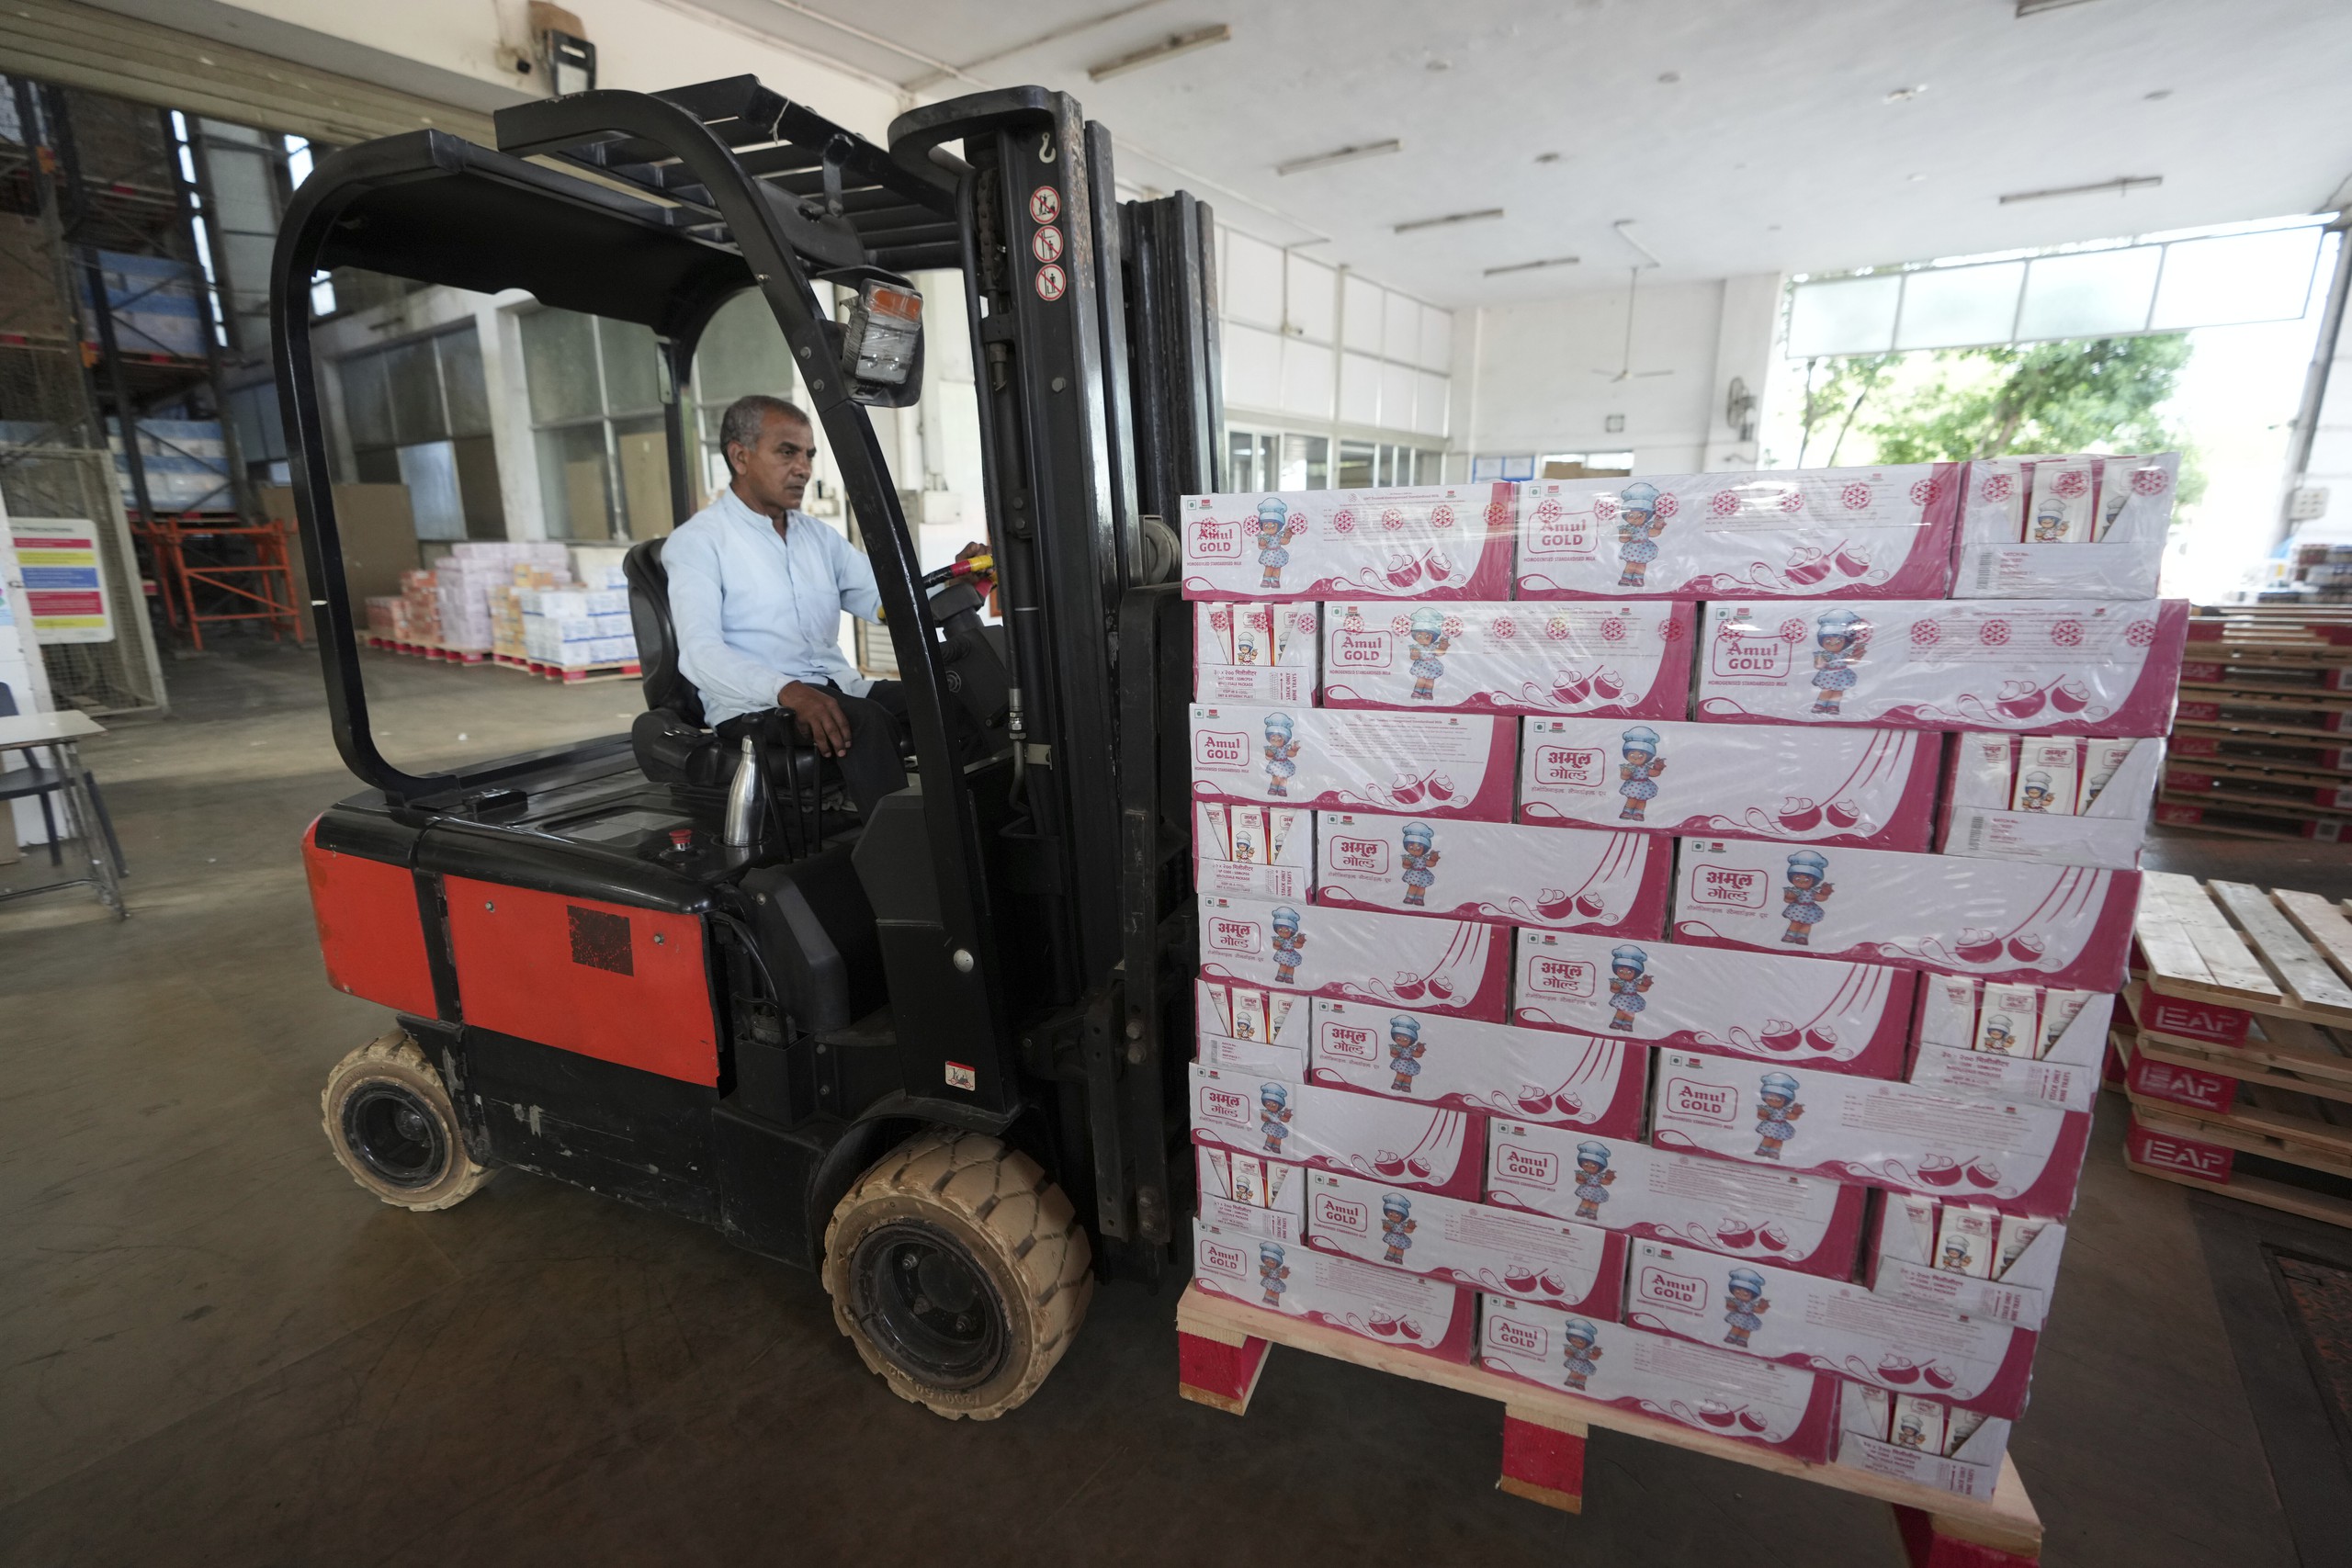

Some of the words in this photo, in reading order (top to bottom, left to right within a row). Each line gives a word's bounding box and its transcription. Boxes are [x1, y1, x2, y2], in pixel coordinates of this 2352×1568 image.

[1540, 520, 1587, 532] Amul
[1197, 529, 1233, 540] Amul
[1542, 535, 1583, 546] GOLD
[1200, 542, 1231, 551] GOLD
[1341, 637, 1382, 649] Amul
[1726, 642, 1779, 657] Amul
[1344, 650, 1380, 660] GOLD
[1728, 659, 1774, 670] GOLD
[1204, 737, 1240, 748] Amul
[1207, 750, 1238, 760] GOLD
[1548, 752, 1593, 768] अमूल
[1550, 766, 1589, 781] गोल्ड
[1341, 841, 1378, 858] अमूल
[1343, 855, 1376, 869] गोल्ड
[1706, 871, 1755, 889] अमूल
[1708, 886, 1749, 902] गोल्ड
[1217, 923, 1251, 937] अमूल
[1220, 935, 1250, 948] गोल्ड
[1542, 963, 1584, 979] अमूल
[1544, 976, 1580, 990] गोल्ड
[1332, 1028, 1367, 1044] अमूल
[1333, 1040, 1365, 1055] गोल्ड
[2053, 1069, 2062, 1082] ONLY
[2062, 1071, 2071, 1088] TRAYS
[1679, 1086, 1726, 1102] Amul
[2049, 1083, 2058, 1100] STACK
[2059, 1089, 2067, 1102] NINE
[1209, 1092, 1240, 1108] अमूल
[1681, 1100, 1722, 1114] GOLD
[1211, 1104, 1238, 1118] गोल्ड
[1507, 1151, 1548, 1168] Amul
[1510, 1164, 1545, 1178] GOLD
[1324, 1201, 1359, 1216] Amul
[1326, 1212, 1357, 1225] GOLD
[1208, 1247, 1238, 1262] Amul
[1210, 1257, 1237, 1269] GOLD
[1652, 1274, 1696, 1292] Amul
[1654, 1287, 1692, 1303] GOLD
[1499, 1323, 1538, 1340] Amul
[1501, 1334, 1535, 1348] GOLD
